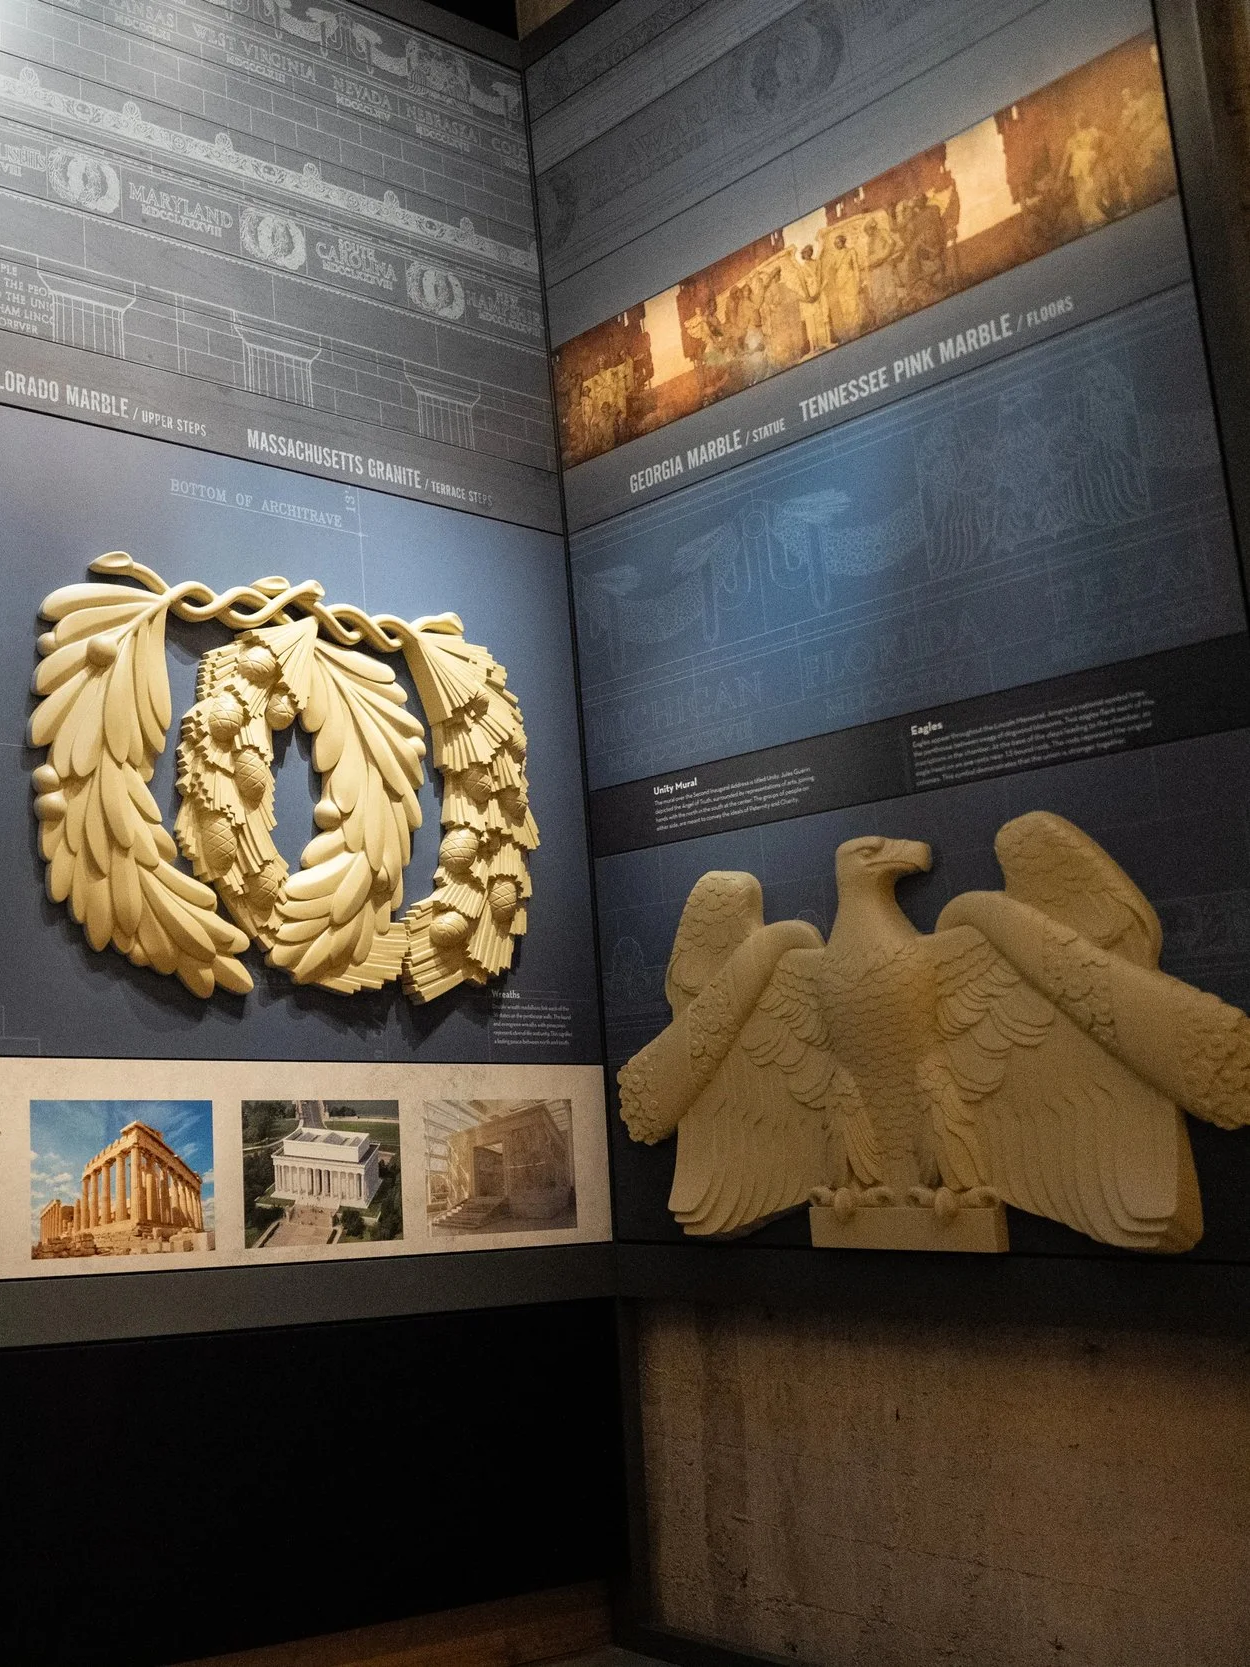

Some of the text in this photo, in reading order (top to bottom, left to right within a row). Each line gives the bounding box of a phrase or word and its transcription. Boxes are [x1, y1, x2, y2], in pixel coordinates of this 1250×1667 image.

[241, 40, 317, 83] VIRGINIA
[331, 74, 393, 111] NEVADA
[128, 182, 234, 230] MARYLAND
[3, 277, 24, 292] THE
[5, 291, 26, 306] THE
[798, 296, 1074, 422] TENNESSEE PINK MARBLE FLOORS
[65, 384, 129, 419] MARBLE
[141, 410, 174, 430] UPPER
[176, 418, 207, 437] STEPS
[246, 428, 494, 507] MASSACHUSETTS GRANITE TERRACE STEPS
[629, 417, 786, 494] GEORGIA MARBLE STATUE
[170, 478, 342, 528] BOTTOM OF ARCHITRAVE
[910, 720, 944, 737] Eagles
[653, 777, 698, 796] Unity Mural
[491, 989, 521, 999] Wreaths
